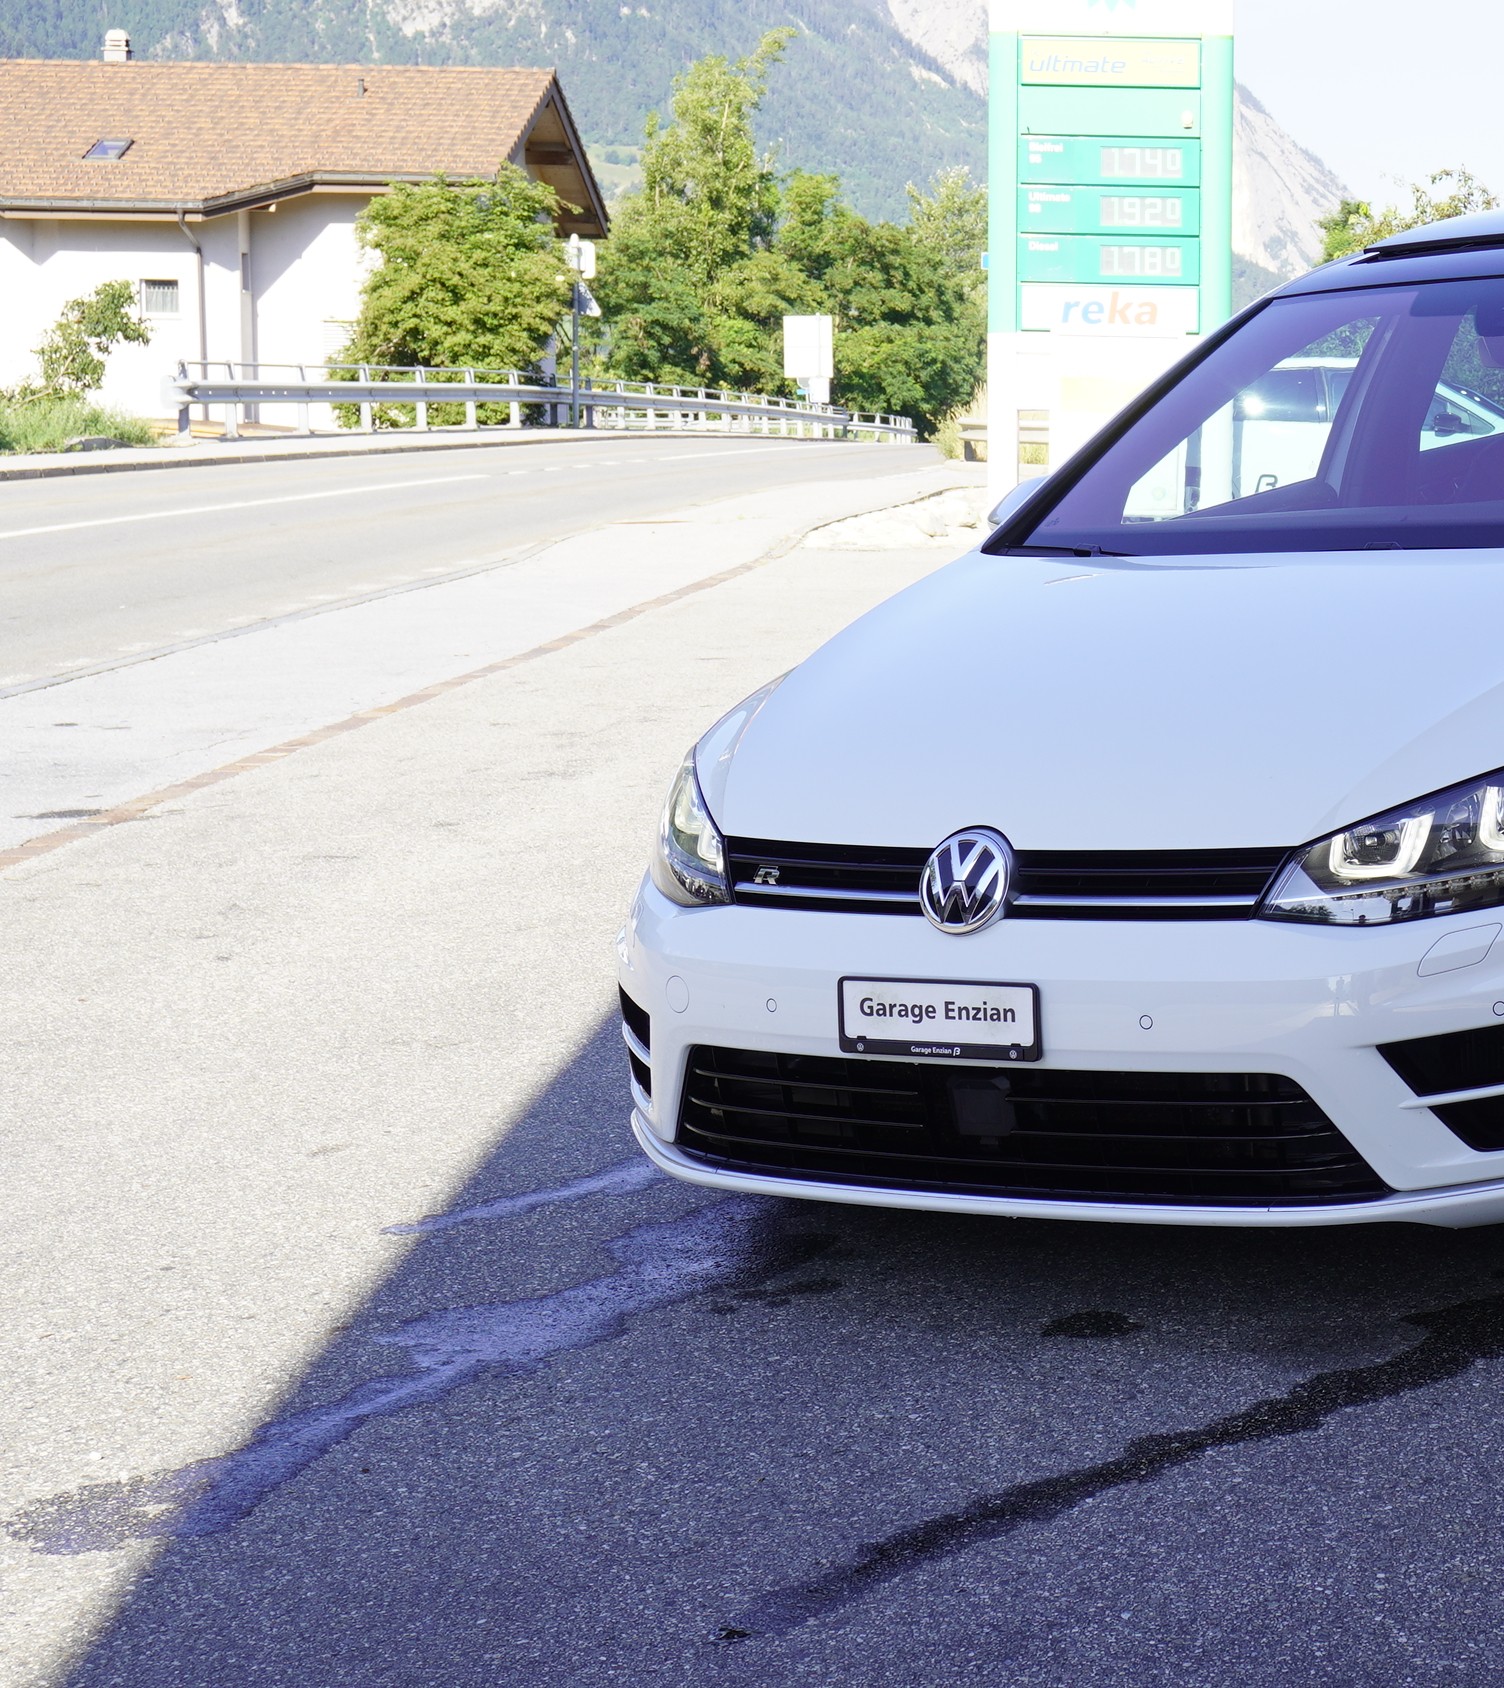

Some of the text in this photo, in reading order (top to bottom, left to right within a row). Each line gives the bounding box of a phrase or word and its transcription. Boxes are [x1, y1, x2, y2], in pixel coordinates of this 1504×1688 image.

[1028, 54, 1127, 74] ultimate
[1028, 241, 1059, 252] Diesel
[1061, 291, 1158, 325] reka
[753, 865, 780, 885] R
[859, 997, 1016, 1024] Garage Enzian
[910, 1045, 952, 1055] Garage Enzian
